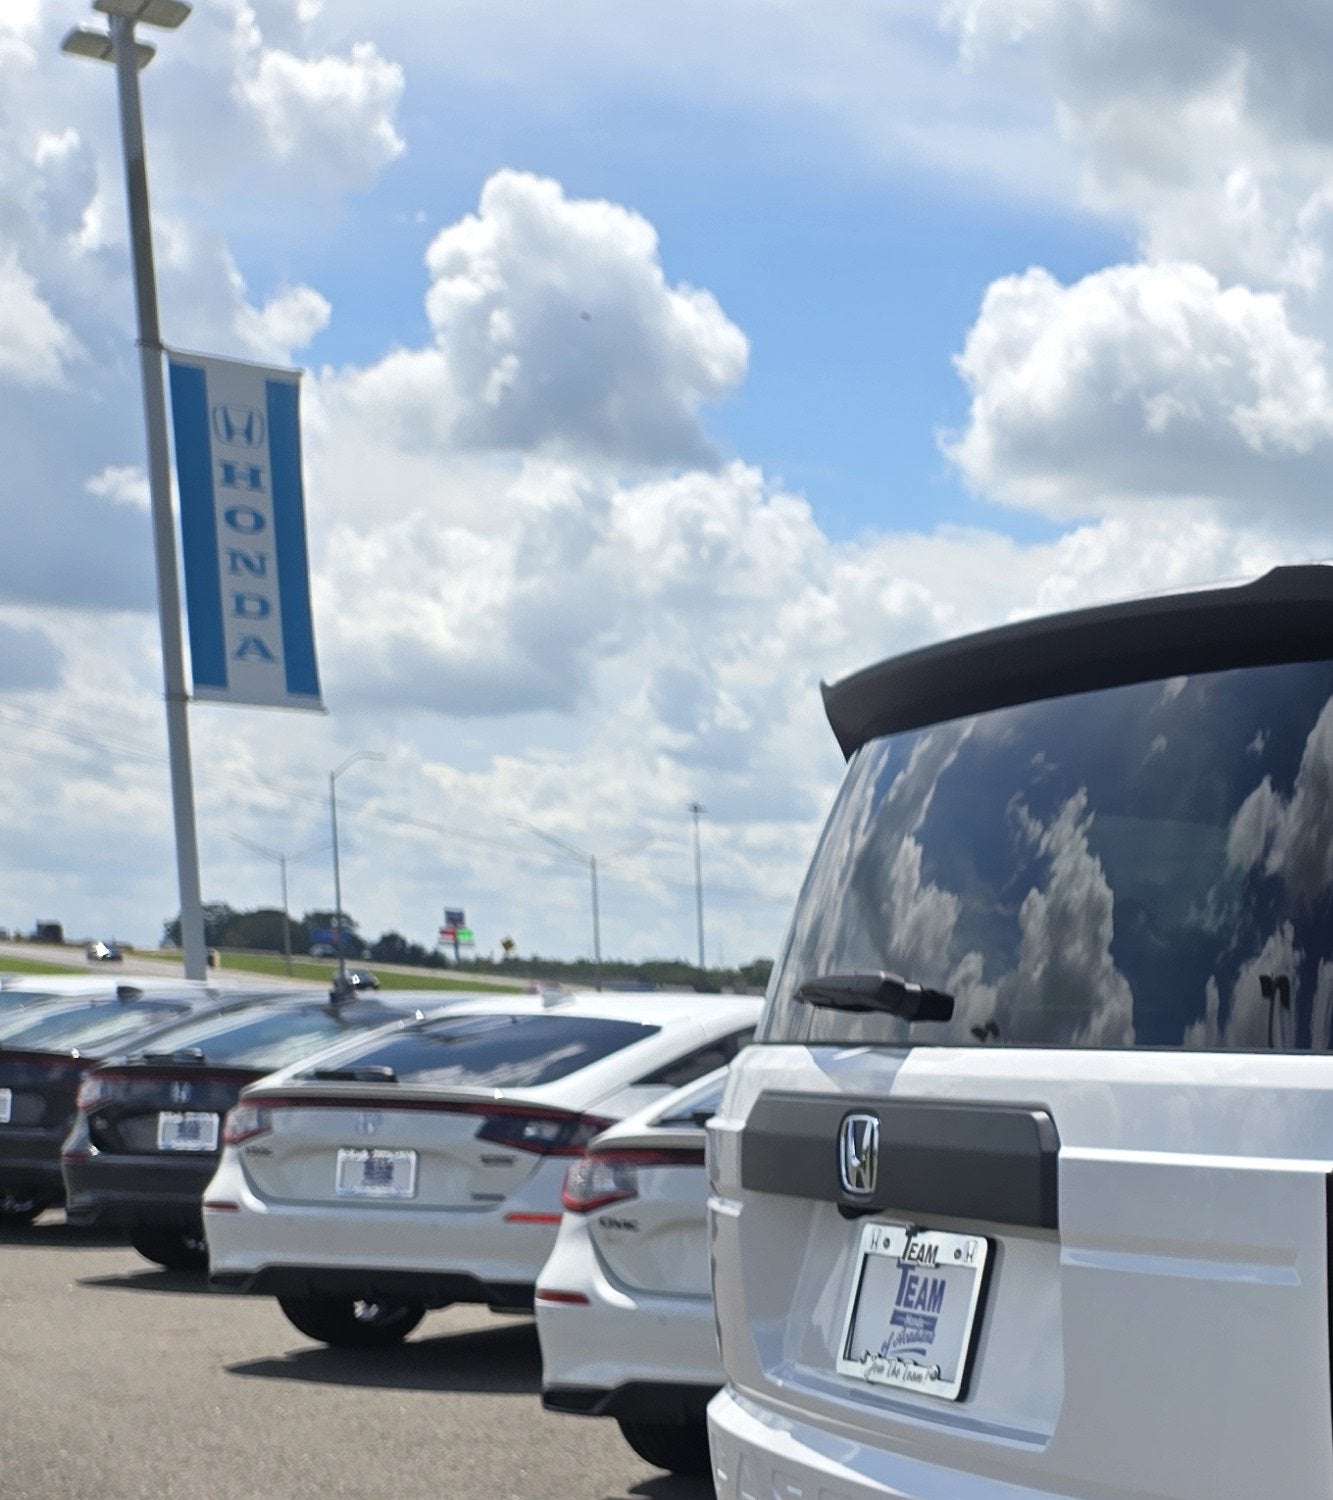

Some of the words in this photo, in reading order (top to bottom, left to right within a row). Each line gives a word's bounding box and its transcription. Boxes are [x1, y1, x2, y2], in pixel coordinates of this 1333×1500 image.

[220, 462, 275, 662] HONDA
[902, 1225, 939, 1266] TEAM
[895, 1258, 947, 1314] TEAM
